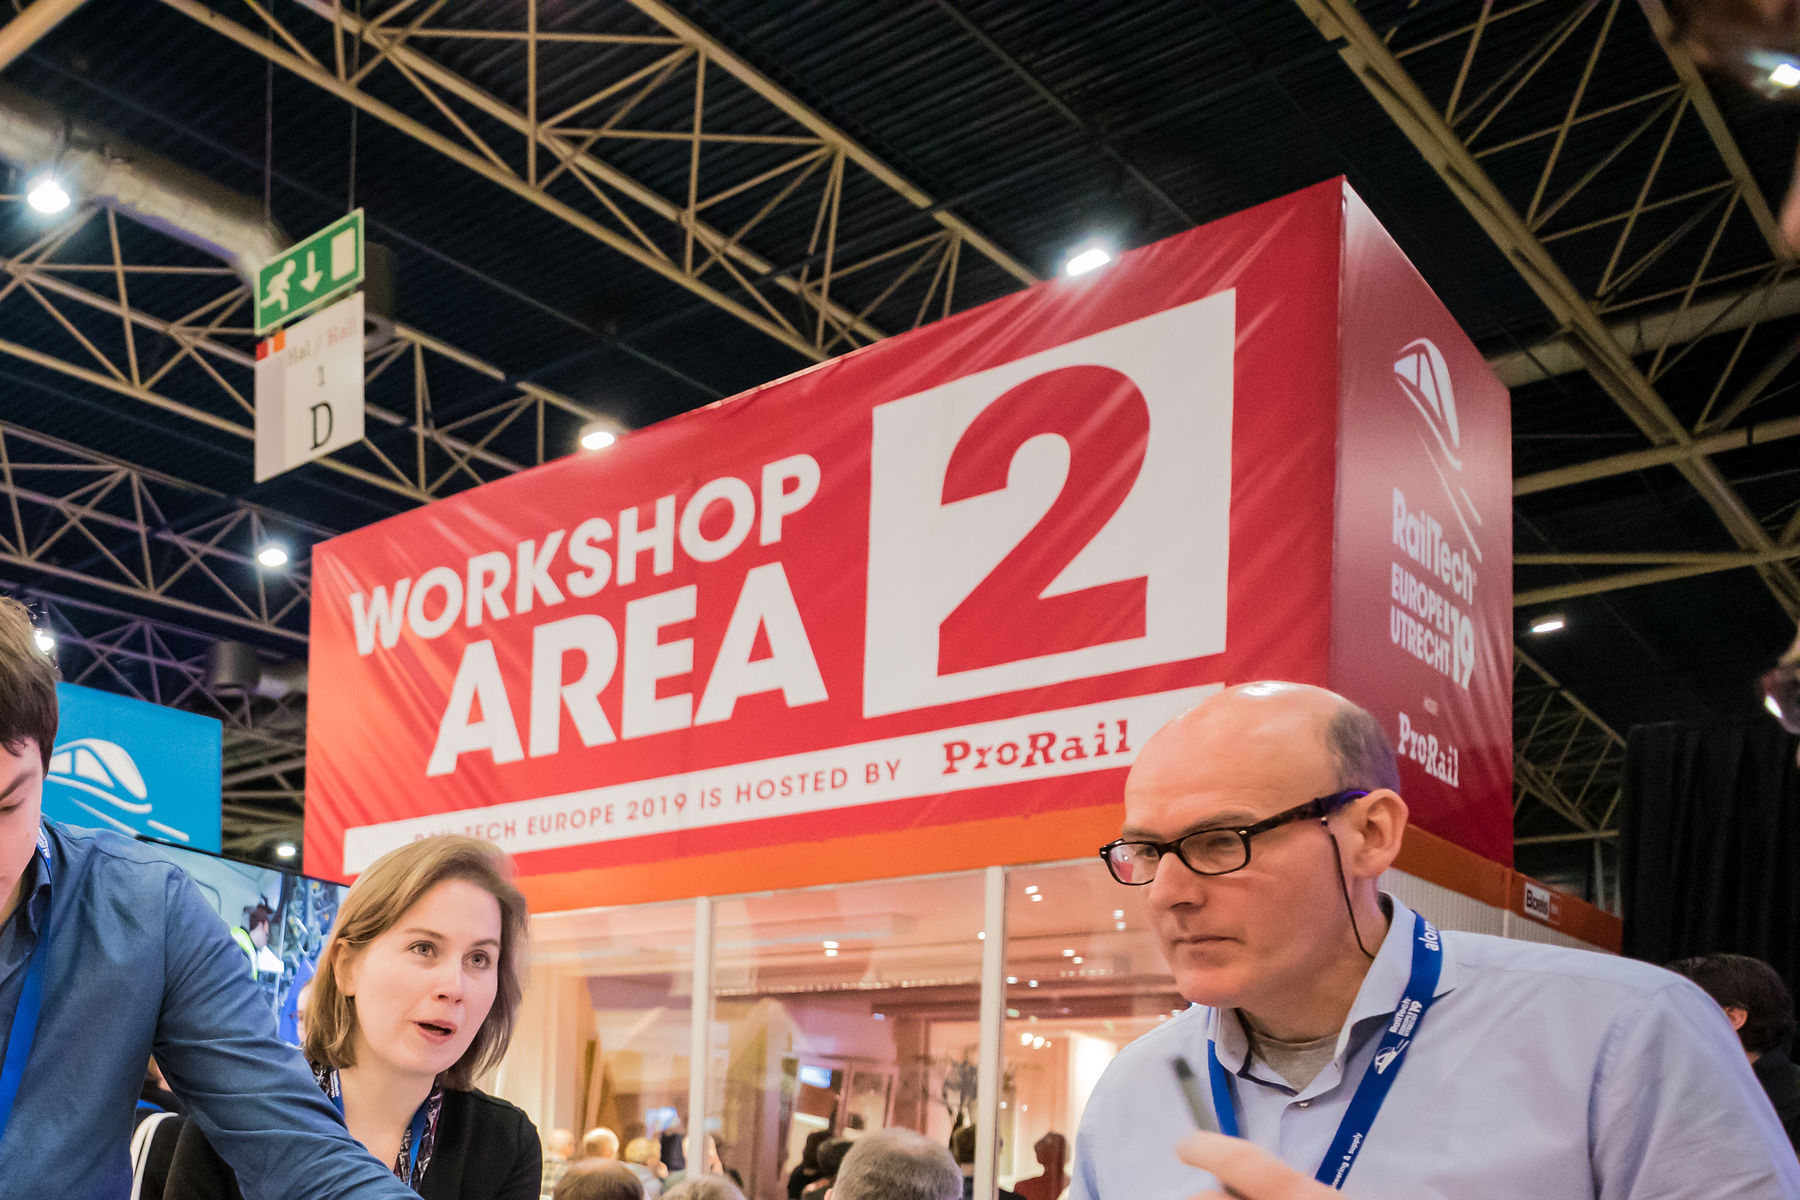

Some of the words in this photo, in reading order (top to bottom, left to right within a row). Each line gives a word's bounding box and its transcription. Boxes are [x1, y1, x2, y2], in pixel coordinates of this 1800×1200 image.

[310, 401, 334, 450] D
[349, 453, 821, 656] WORKSHOP
[936, 364, 1151, 678] 2
[1391, 486, 1474, 606] RailTech
[1390, 604, 1450, 676] UTRECHT
[1391, 561, 1445, 628] EUROPE
[426, 560, 829, 776] AREA
[1450, 607, 1475, 690] 19
[527, 803, 615, 836] EUROPE
[626, 792, 687, 822] 2019
[700, 788, 722, 809] IS
[735, 767, 848, 805] HOSTED
[865, 758, 902, 785] BY
[941, 718, 1132, 775] ProRail
[1397, 710, 1459, 788] ProRail
